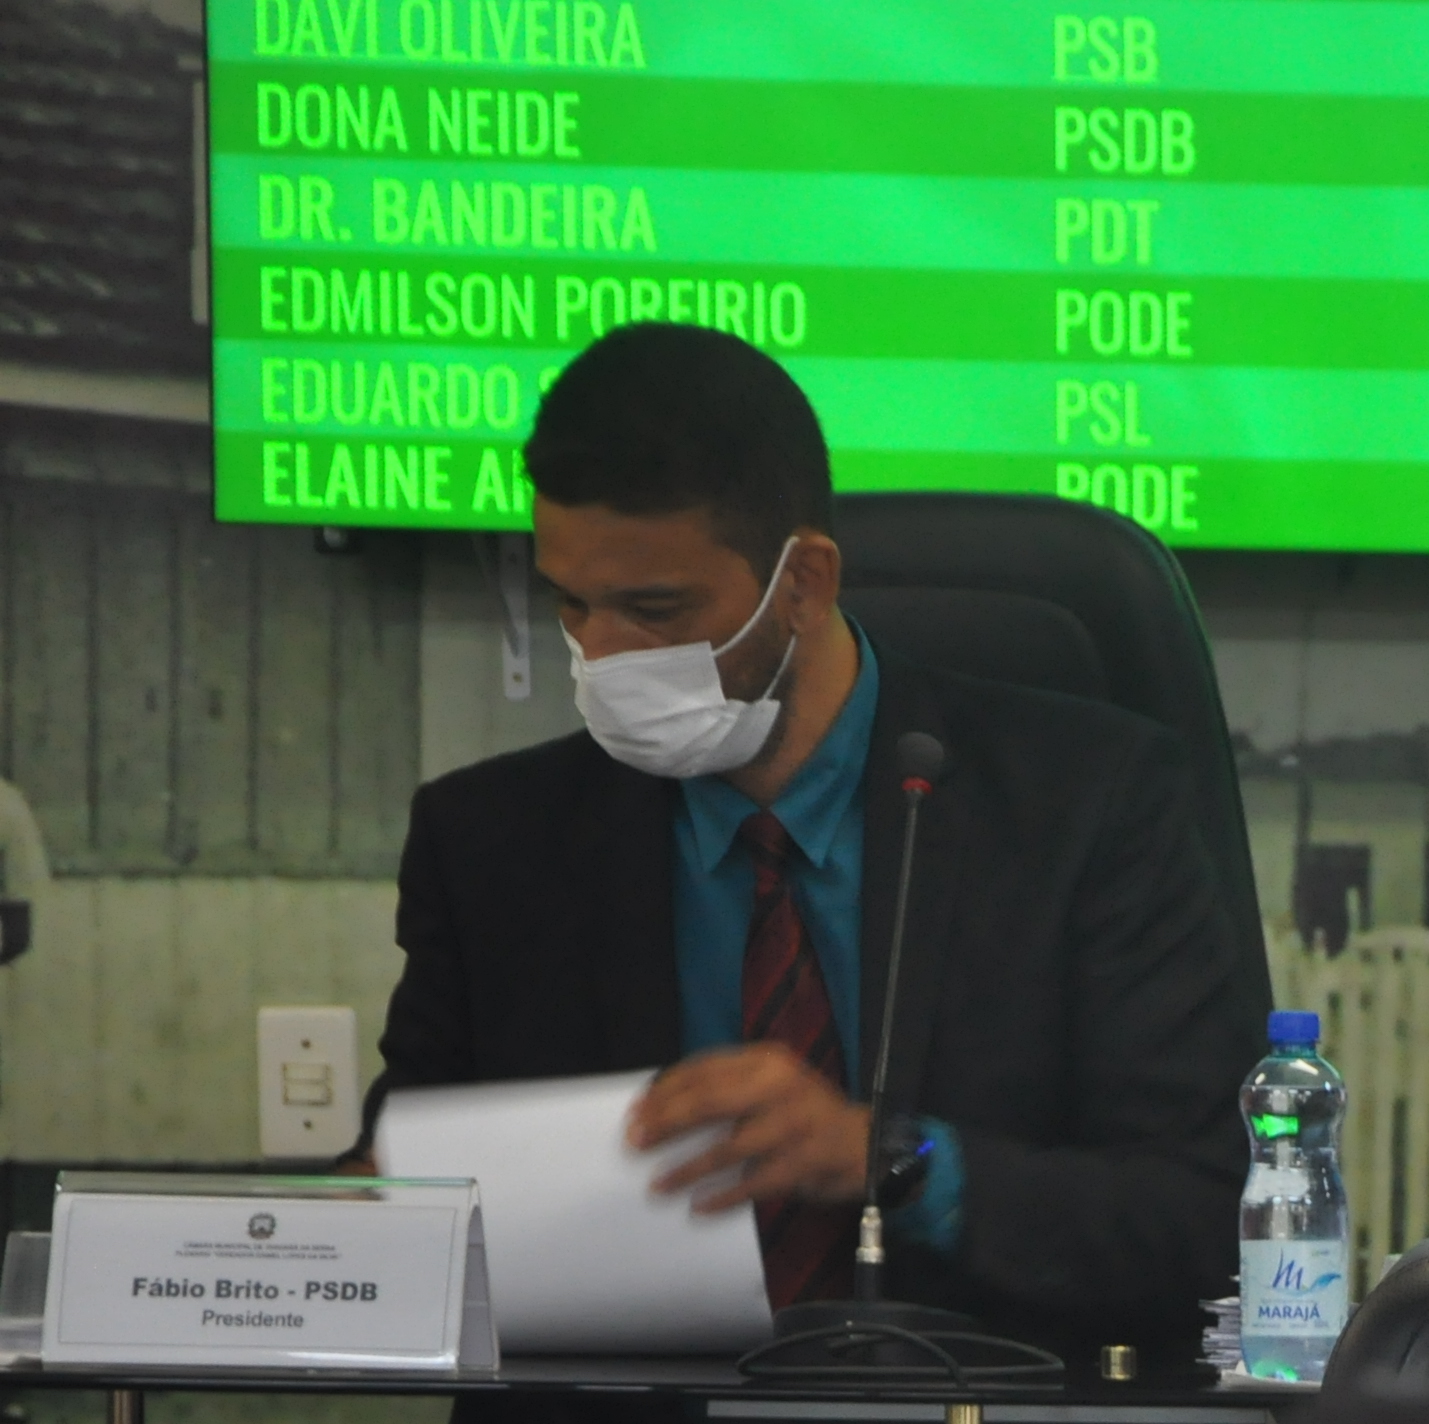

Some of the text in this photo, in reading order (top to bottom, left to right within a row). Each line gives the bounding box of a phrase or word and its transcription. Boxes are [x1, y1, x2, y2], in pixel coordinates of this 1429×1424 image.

[255, 0, 646, 69] DAVI OLIVEIRA
[1053, 15, 1159, 83] PSB
[256, 81, 581, 158] DONA NEIDE
[1054, 106, 1196, 175] PSDB
[257, 174, 658, 253] DR. BANDEIRA
[1055, 198, 1160, 266] PDT
[259, 266, 537, 338] EDMILSON
[1055, 289, 1194, 357] PODE
[260, 358, 521, 431] EDUARDO
[1055, 380, 1152, 447] PSL
[263, 441, 452, 513] ELAINE
[1056, 462, 1199, 531] PODE
[132, 1276, 205, 1299] Fábio
[214, 1279, 279, 1301] Brito
[304, 1281, 379, 1302] PSDB
[201, 1309, 304, 1328] Presidente
[1258, 1302, 1320, 1321] MARAJÁ
